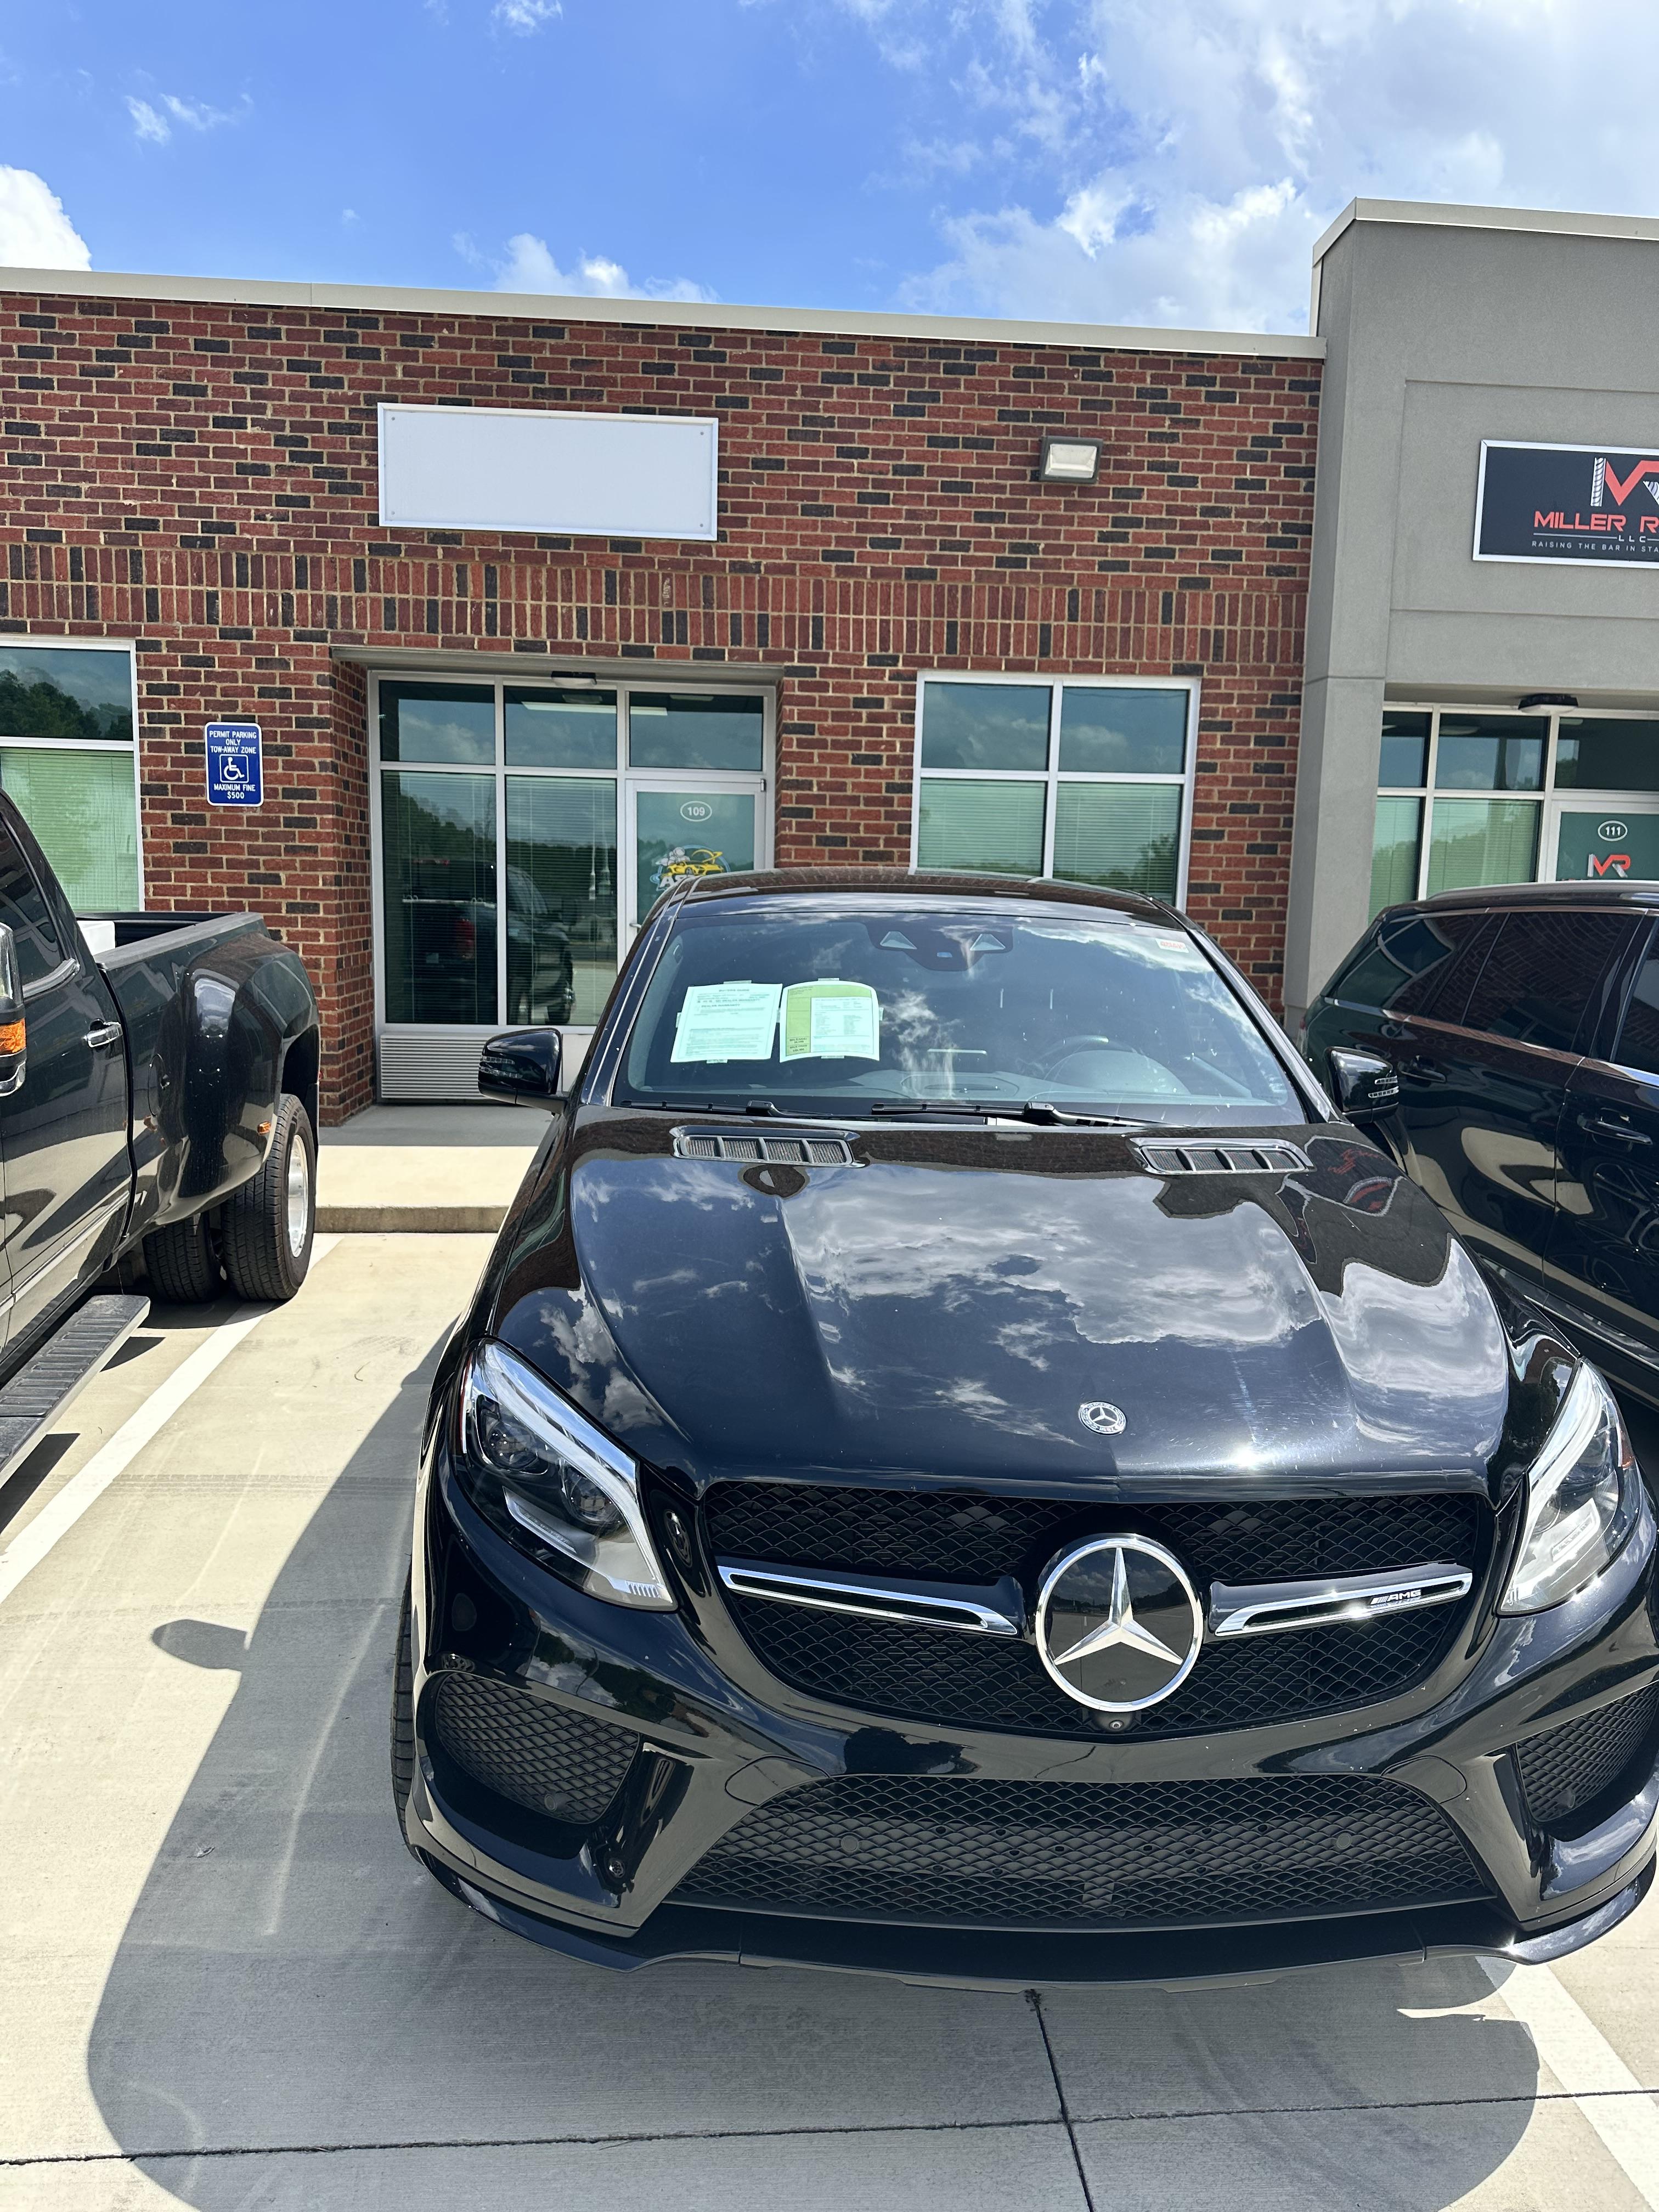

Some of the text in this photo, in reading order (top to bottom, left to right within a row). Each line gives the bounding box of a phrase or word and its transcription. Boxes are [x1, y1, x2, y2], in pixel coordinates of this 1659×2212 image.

[1534, 511, 1626, 532] MILLER
[1532, 540, 1572, 549] RAISING
[232, 731, 257, 739] PARKING
[227, 791, 245, 799] $500
[687, 806, 706, 816] 109
[1605, 826, 1621, 836] 111
[1587, 853, 1632, 878] MR
[1386, 1589, 1421, 1601] AMG
